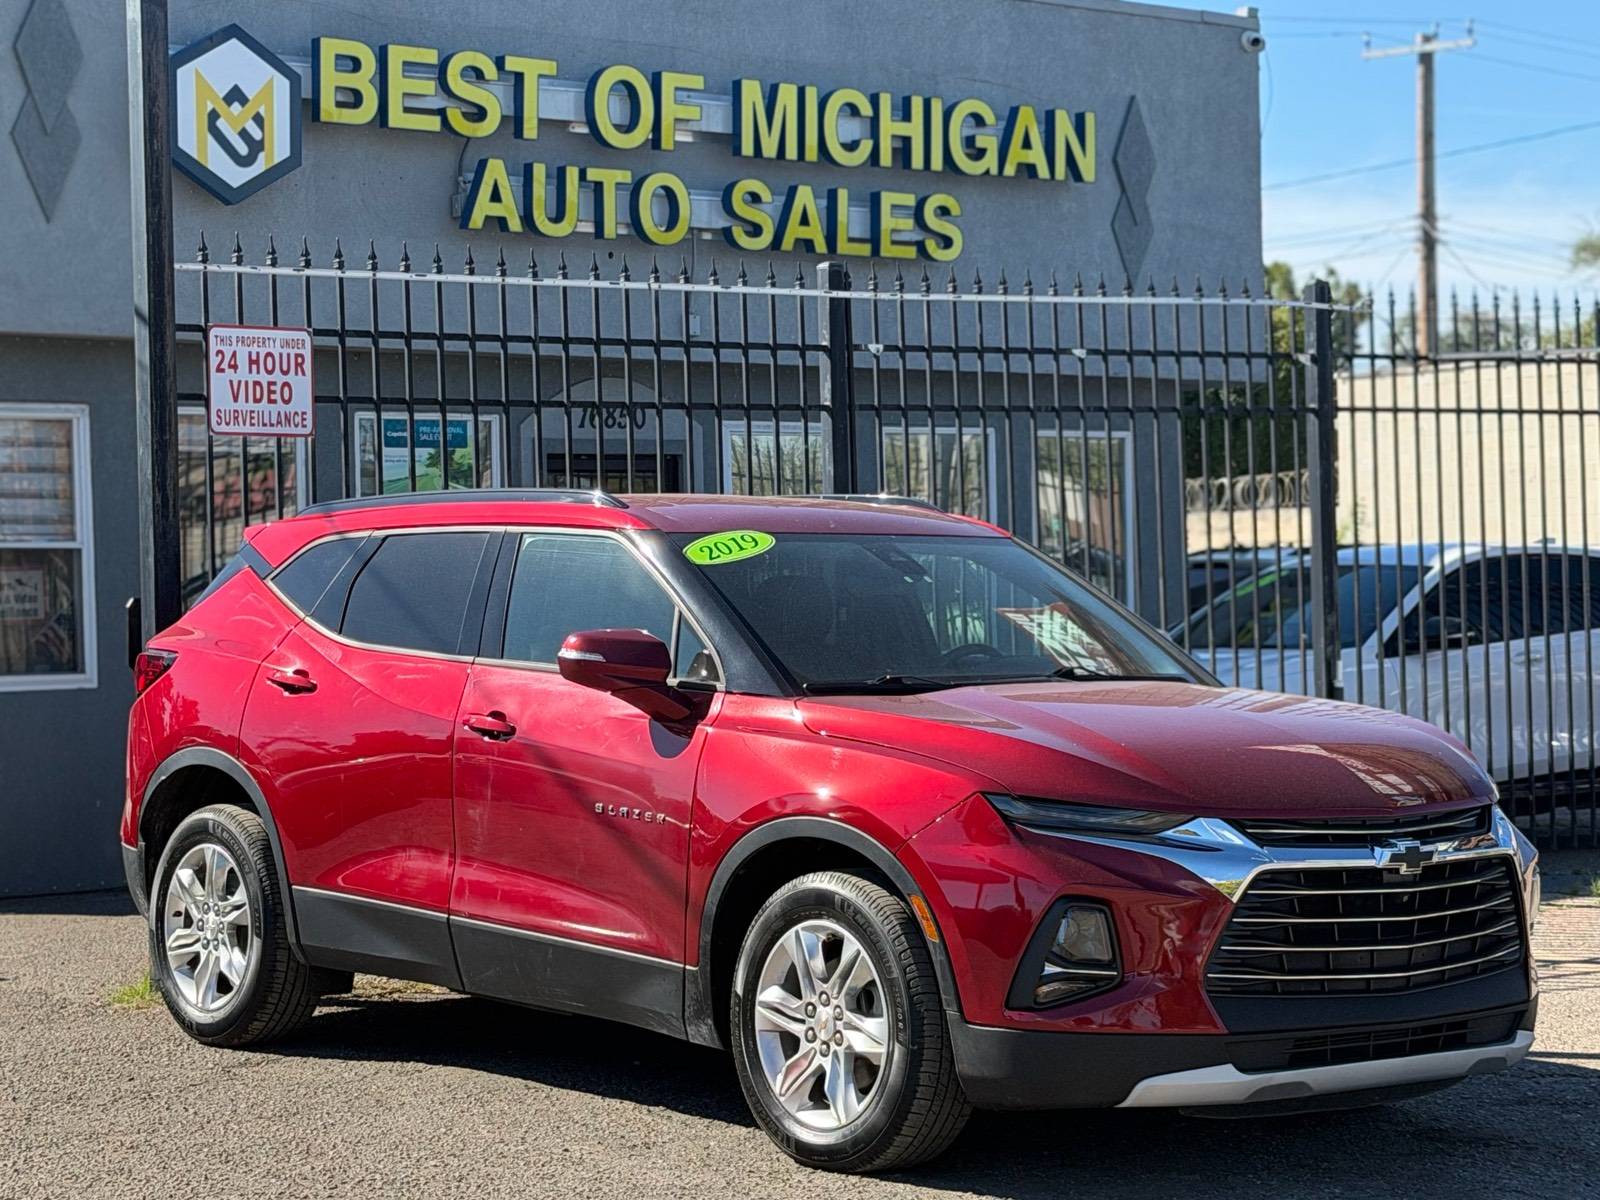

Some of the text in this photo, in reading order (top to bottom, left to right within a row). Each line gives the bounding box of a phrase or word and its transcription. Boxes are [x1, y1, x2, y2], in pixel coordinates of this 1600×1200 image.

[312, 37, 1097, 183] BEST OF MICHIGAN
[460, 158, 964, 262] AUTO SALES
[214, 334, 306, 350] THIS PROPERTY UNDER
[215, 349, 306, 377] 24 HOUR
[228, 379, 293, 406] VIDEO
[215, 408, 308, 429] SURVEILLANCE
[699, 533, 759, 561] 2019
[594, 802, 665, 825] BLAZER
